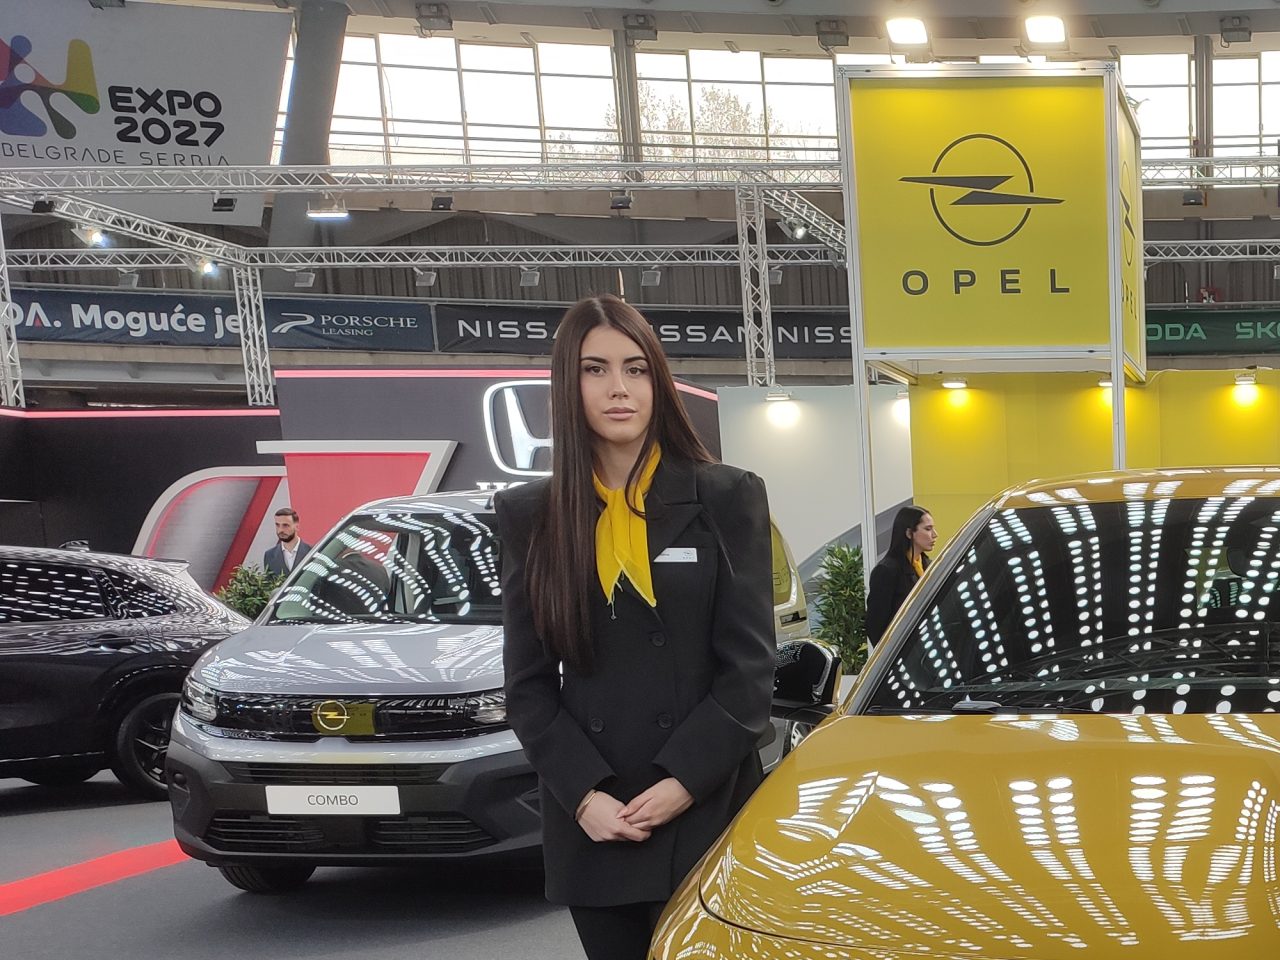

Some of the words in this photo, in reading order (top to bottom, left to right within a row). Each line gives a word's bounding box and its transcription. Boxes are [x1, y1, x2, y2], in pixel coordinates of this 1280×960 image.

[108, 85, 222, 118] EXPO
[114, 116, 225, 147] 2027
[1, 142, 127, 165] BELGRADE
[139, 151, 230, 166] SERBIA
[902, 269, 1070, 295] OPEL
[71, 303, 206, 337] Moguće
[214, 307, 241, 339] je
[320, 314, 418, 328] PORSCHE
[322, 328, 373, 336] LEASING
[458, 319, 561, 340] NISS
[653, 324, 757, 343] SSAN
[1147, 323, 1207, 341] ODA
[307, 795, 359, 806] COMBO
